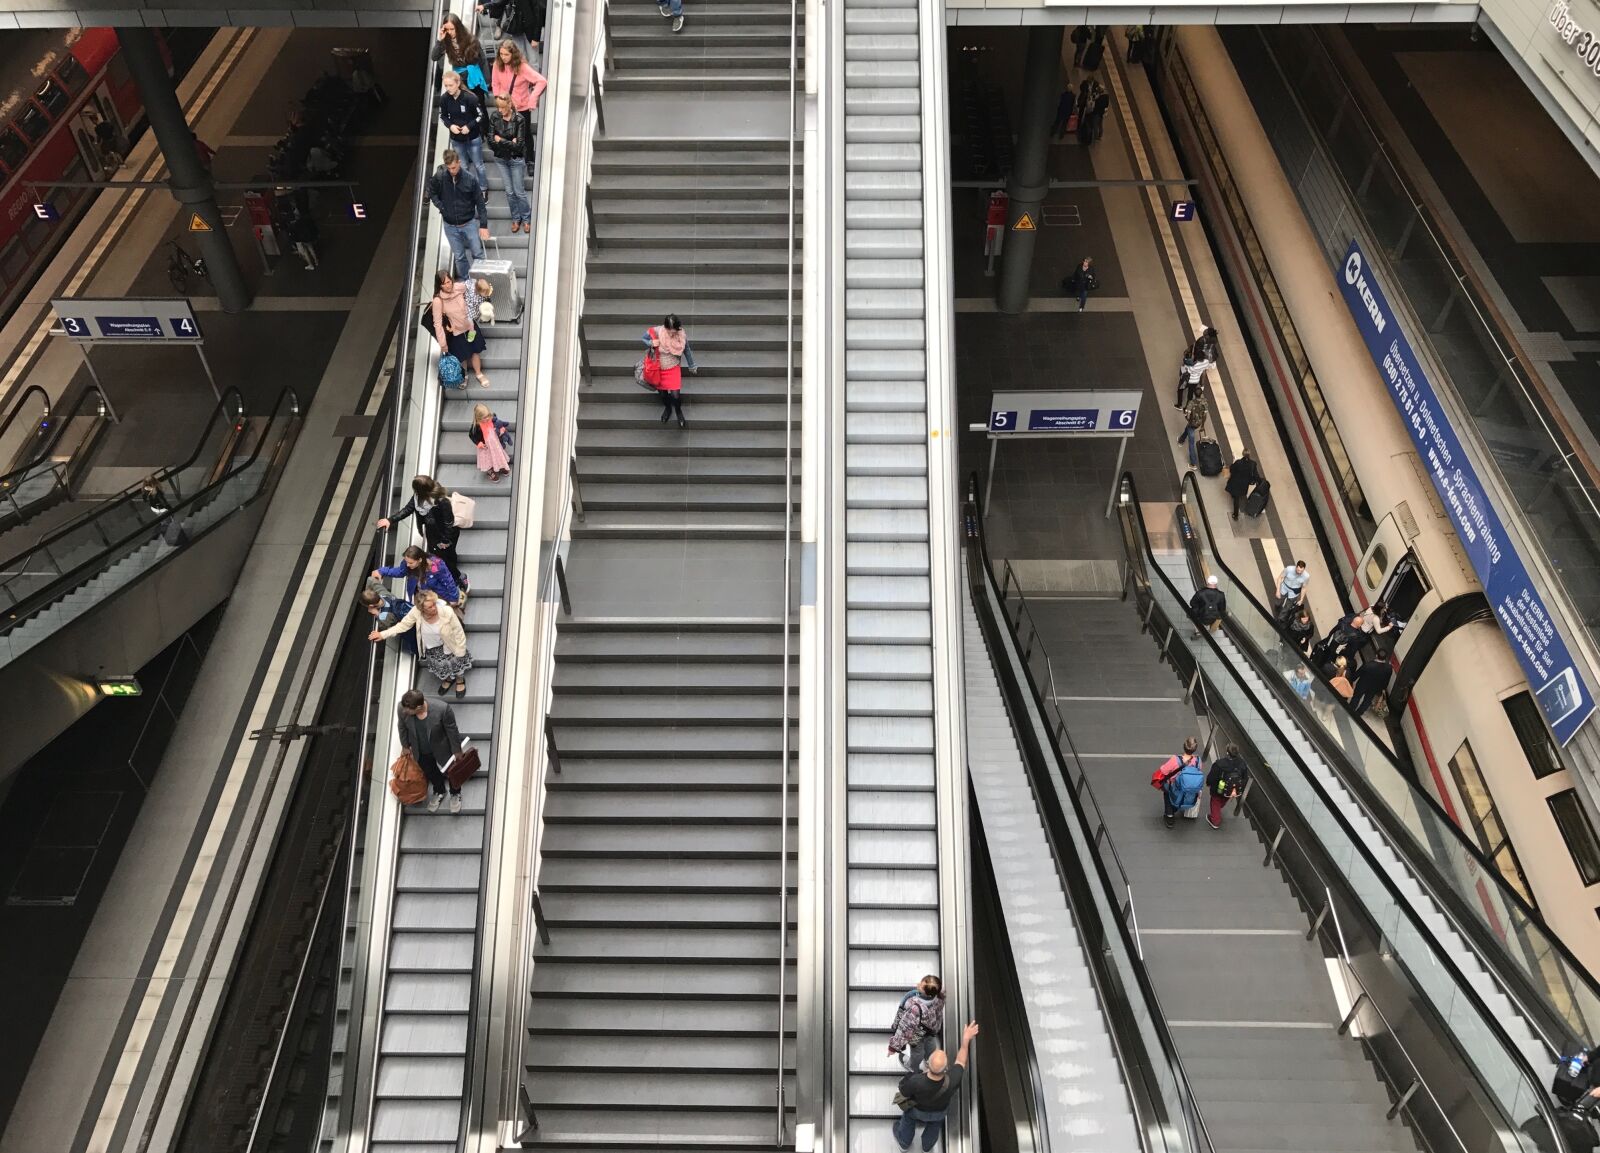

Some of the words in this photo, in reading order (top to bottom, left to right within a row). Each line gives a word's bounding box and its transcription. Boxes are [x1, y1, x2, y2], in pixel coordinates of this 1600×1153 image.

[33, 204, 49, 219] E
[353, 203, 366, 218] E
[1174, 203, 1187, 218] E
[1356, 274, 1386, 334] KERN
[64, 317, 80, 333] 3
[180, 318, 193, 333] 4
[994, 411, 1008, 427] 5
[1119, 410, 1133, 426] 6
[1382, 354, 1398, 384] (030)
[1398, 386, 1409, 403] 75
[1404, 399, 1414, 415] 81
[1411, 412, 1426, 440] 45-0
[1428, 447, 1477, 543] www.e-kern.com
[1389, 339, 1416, 394] Übersetzen
[1419, 400, 1452, 466] Dolmetschen
[1453, 468, 1501, 564] Sprachentraining
[1516, 599, 1526, 612] der
[1525, 609, 1550, 647] kostenlose
[1521, 588, 1531, 603] Die
[1529, 600, 1554, 639] KERN-App,
[1498, 604, 1549, 680] www.m.e-kern.com
[1505, 594, 1536, 642] Vokabeltrainer
[1534, 640, 1544, 653] für
[1541, 651, 1554, 668] Sie!
